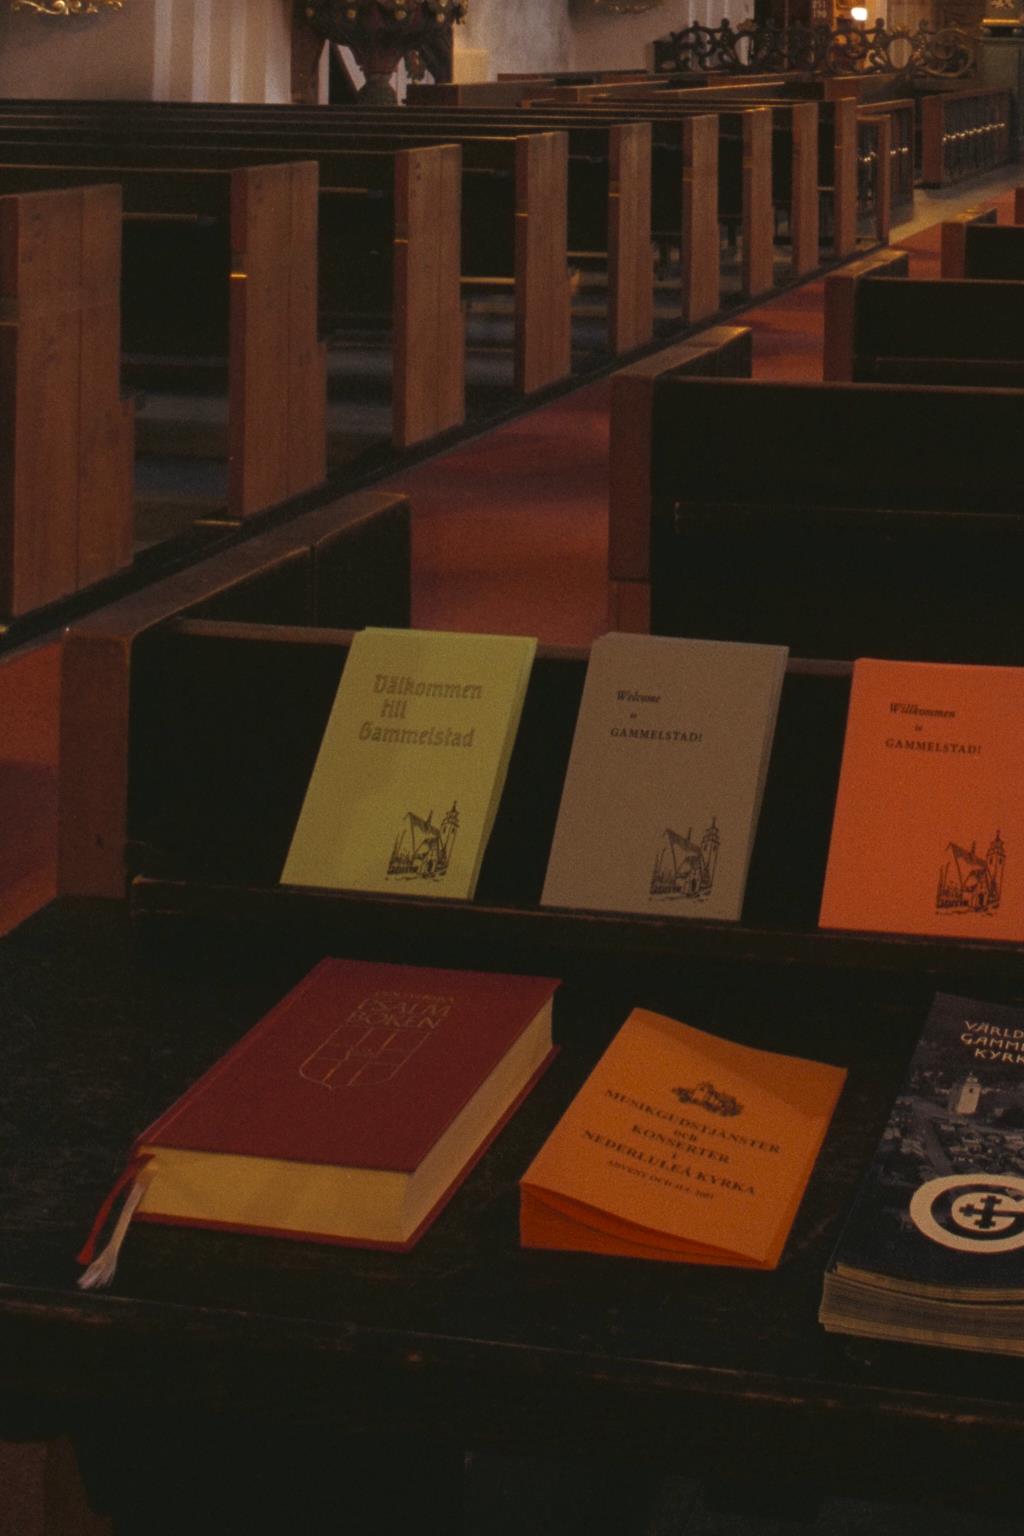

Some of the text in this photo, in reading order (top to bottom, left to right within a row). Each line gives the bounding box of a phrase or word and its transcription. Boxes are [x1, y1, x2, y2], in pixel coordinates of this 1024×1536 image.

[374, 673, 483, 700] Välkommen
[616, 690, 662, 704] Welcome
[380, 698, 408, 720] till
[889, 702, 957, 719] Willkommen
[358, 721, 476, 748] Gammelstad
[609, 727, 704, 743] GAMMELSTAD!
[885, 737, 983, 755] GAMMELSTAD!
[605, 1089, 781, 1154] MUSIKGUDSTJÄNSTER
[632, 1125, 730, 1164] KONSERTER
[673, 1129, 697, 1142] och
[696, 1171, 756, 1195] KYRKA
